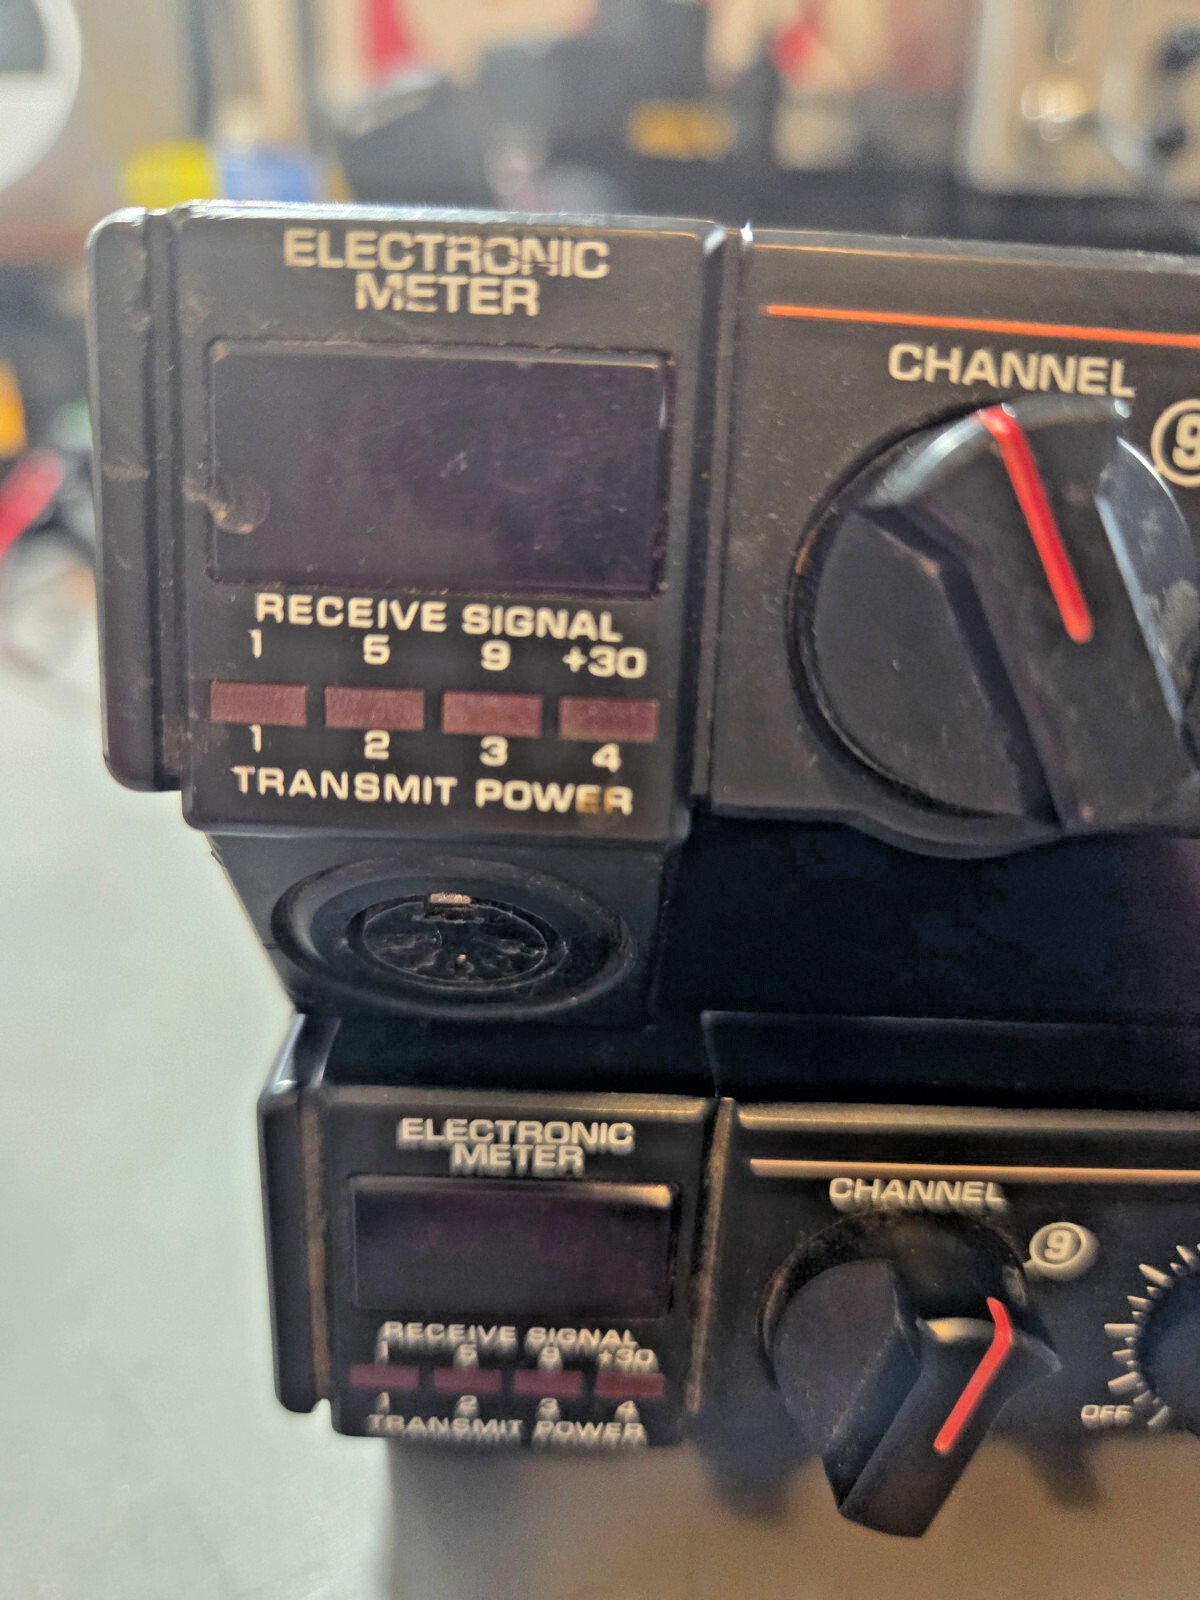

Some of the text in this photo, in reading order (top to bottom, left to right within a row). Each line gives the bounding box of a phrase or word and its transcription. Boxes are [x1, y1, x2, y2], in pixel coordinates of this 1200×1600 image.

[283, 228, 610, 279] ELECTRONIC
[355, 272, 540, 316] METER
[888, 343, 1136, 398] CHANNEL
[1172, 412, 1200, 470] 9
[255, 592, 623, 643] RECEIVE SIGNAL
[249, 629, 648, 679] 1 5 9 +30
[250, 724, 623, 773] 1 2 3 4
[232, 765, 633, 816] TRANSMIT POWER
[398, 1117, 636, 1150] ELECTRONIC
[451, 1143, 585, 1174] METER
[829, 1177, 1006, 1209] CHANNEL
[1044, 1230, 1072, 1257] 9
[379, 1321, 639, 1354] RECEIVE SIGNAL
[456, 1395, 478, 1417] 2
[538, 1397, 560, 1420] 3
[615, 1400, 639, 1422] 4
[1081, 1404, 1133, 1428] OFF
[366, 1413, 647, 1448] TRANSMIT POWER
